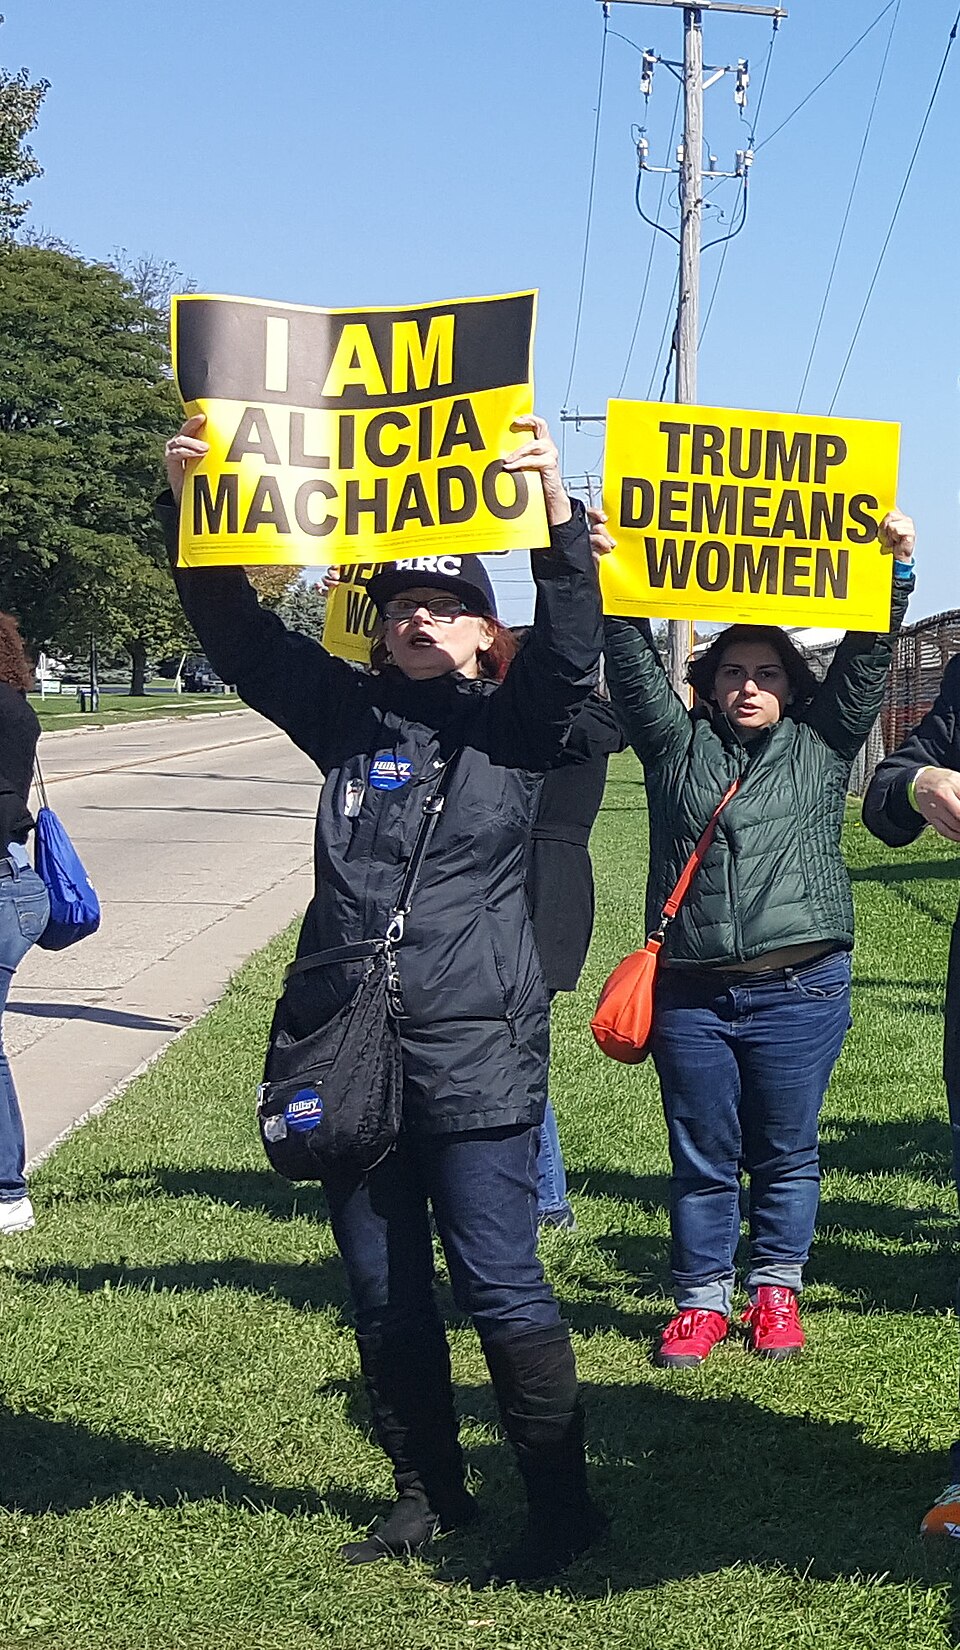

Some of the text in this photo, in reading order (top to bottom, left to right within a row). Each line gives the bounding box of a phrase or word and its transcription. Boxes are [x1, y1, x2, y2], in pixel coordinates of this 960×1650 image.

[265, 314, 455, 396] I AM
[225, 399, 486, 469] ALICIA
[659, 421, 847, 484] TRUMP
[192, 458, 529, 537] MACHADO
[620, 477, 879, 544] DEMEANS
[644, 537, 849, 599] WOMEN
[288, 1098, 319, 1113] Hillary
